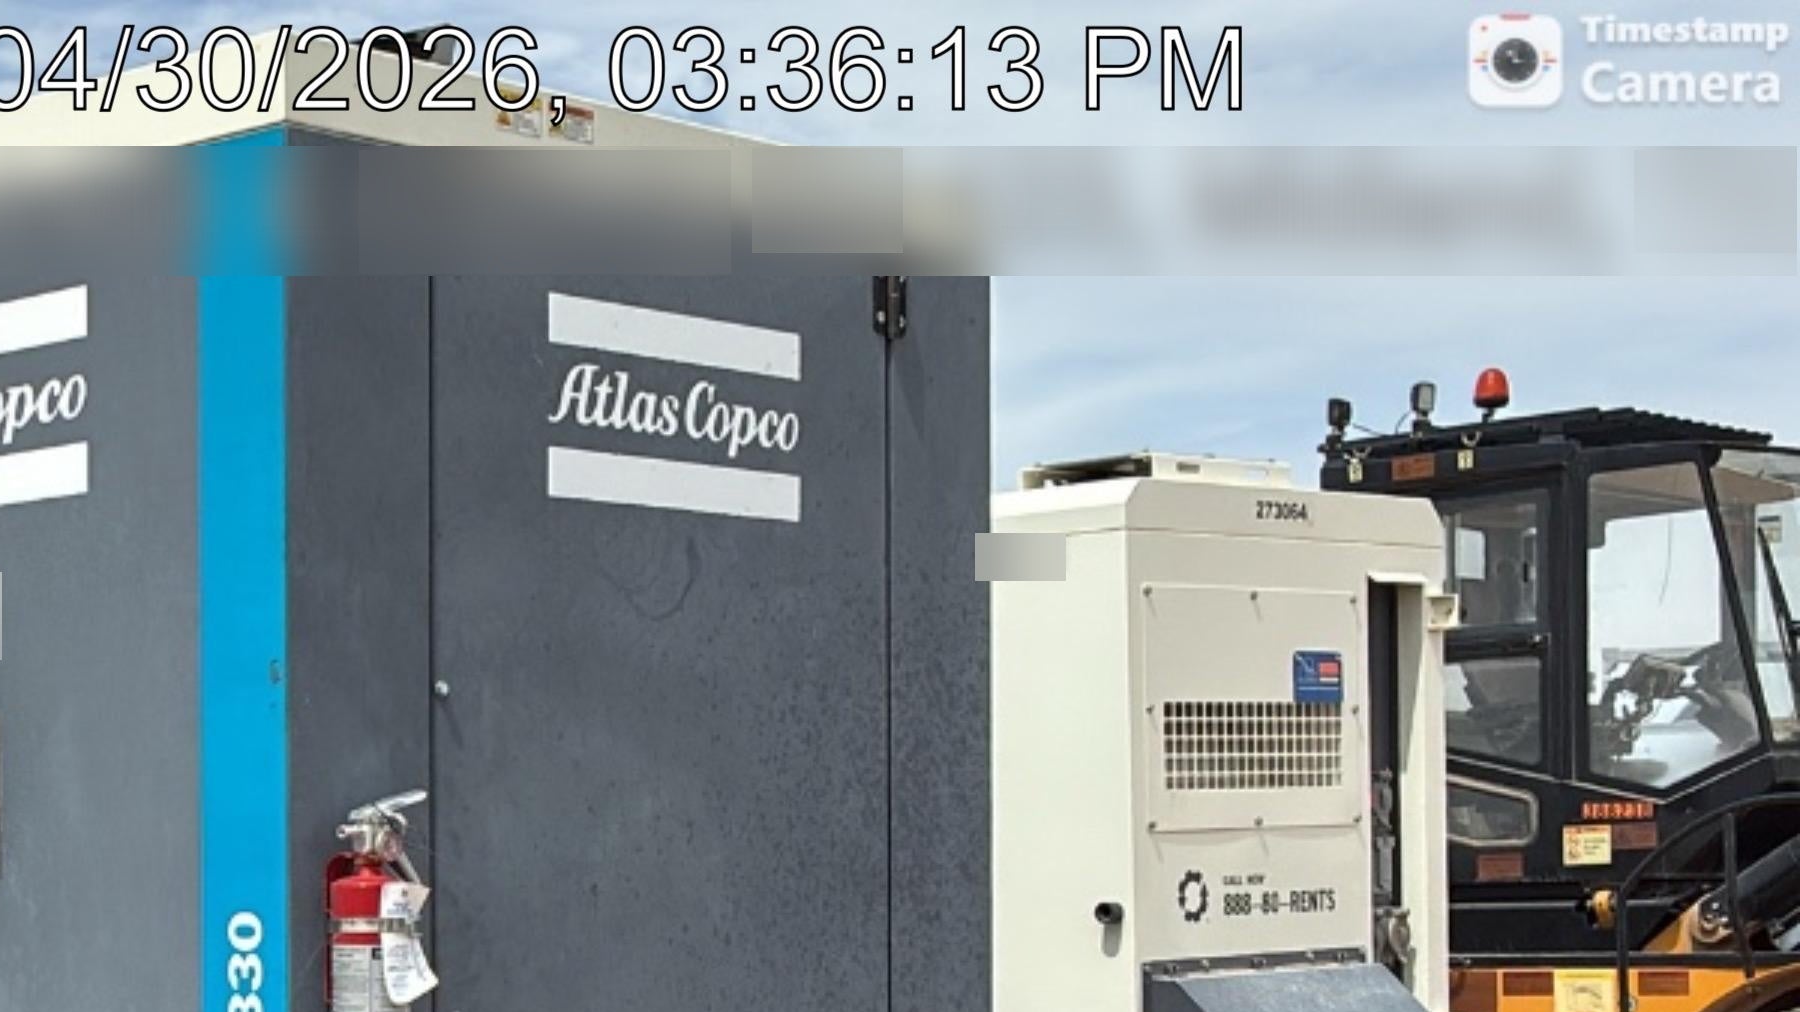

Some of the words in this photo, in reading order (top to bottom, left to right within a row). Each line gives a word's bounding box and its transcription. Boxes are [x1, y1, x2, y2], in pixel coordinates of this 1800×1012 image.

[548, 363, 680, 436] Atlas
[684, 380, 800, 458] Copco
[1255, 500, 1309, 521] 273064
[1224, 889, 1335, 915] 888-80-RENTS
